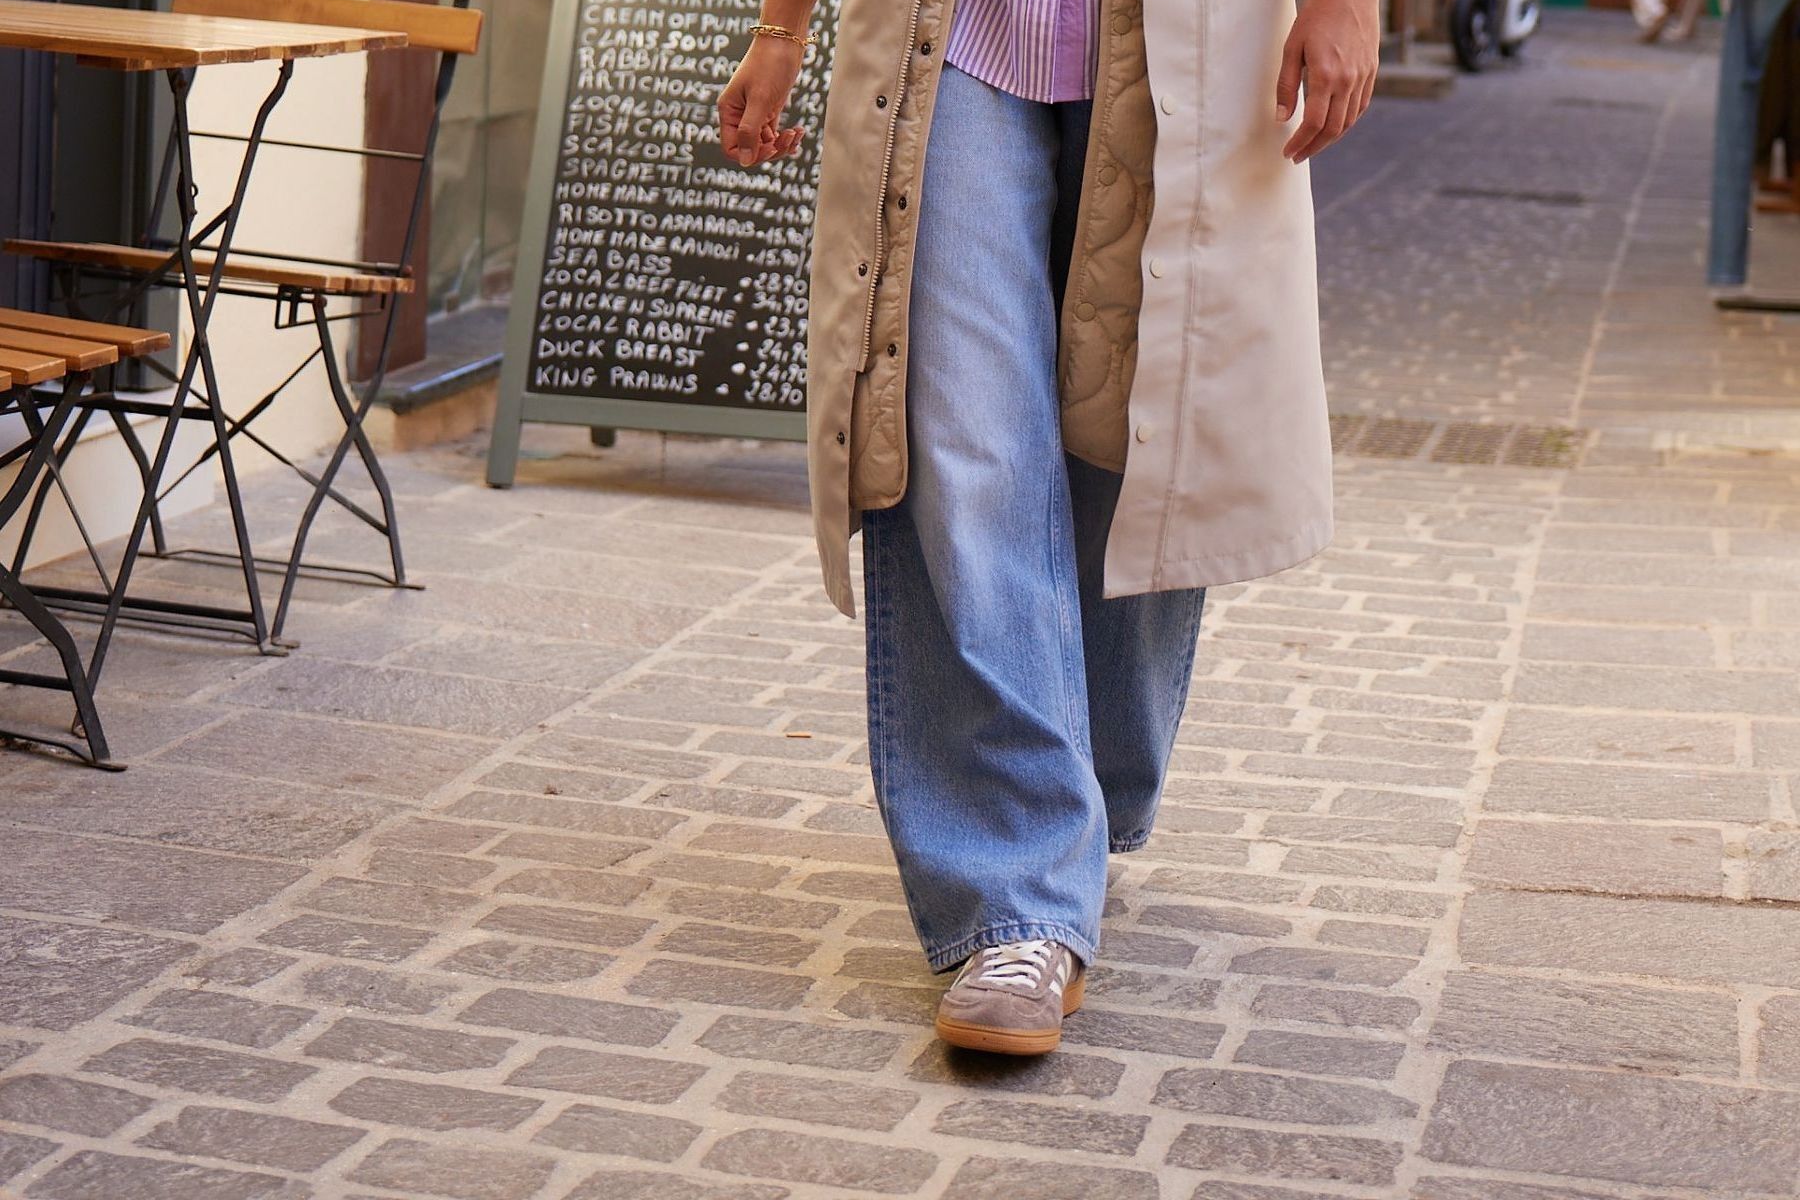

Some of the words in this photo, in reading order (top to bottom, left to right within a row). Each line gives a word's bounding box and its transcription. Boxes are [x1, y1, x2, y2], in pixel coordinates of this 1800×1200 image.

[584, 5, 665, 28] CREAM
[582, 27, 659, 49] CLAMS
[661, 31, 729, 54] SOUP
[579, 47, 675, 73] RABBIT
[569, 95, 649, 118] LOCAL
[568, 113, 629, 136] FISH
[562, 134, 694, 163] SCALLOPS
[563, 157, 693, 188] SPAGHETTI
[555, 182, 612, 200] HOME
[612, 184, 660, 204] MADE
[559, 203, 658, 230] RISOTTO
[659, 213, 755, 238] ASPARAGUS
[554, 226, 607, 247] HOME
[609, 230, 667, 253] MADE
[547, 245, 598, 267] SEA
[605, 249, 673, 275] BASS
[543, 267, 621, 290] LOCAL
[624, 272, 677, 295] BEEF
[541, 290, 645, 316] CHICKEN
[646, 297, 737, 329] SUPREME
[539, 313, 619, 335] LOCAL
[625, 317, 716, 346] RABBIT
[538, 338, 605, 359] DUCK
[615, 338, 705, 367] BREAST
[536, 362, 598, 388] KING
[610, 365, 698, 395] PRAWNS
